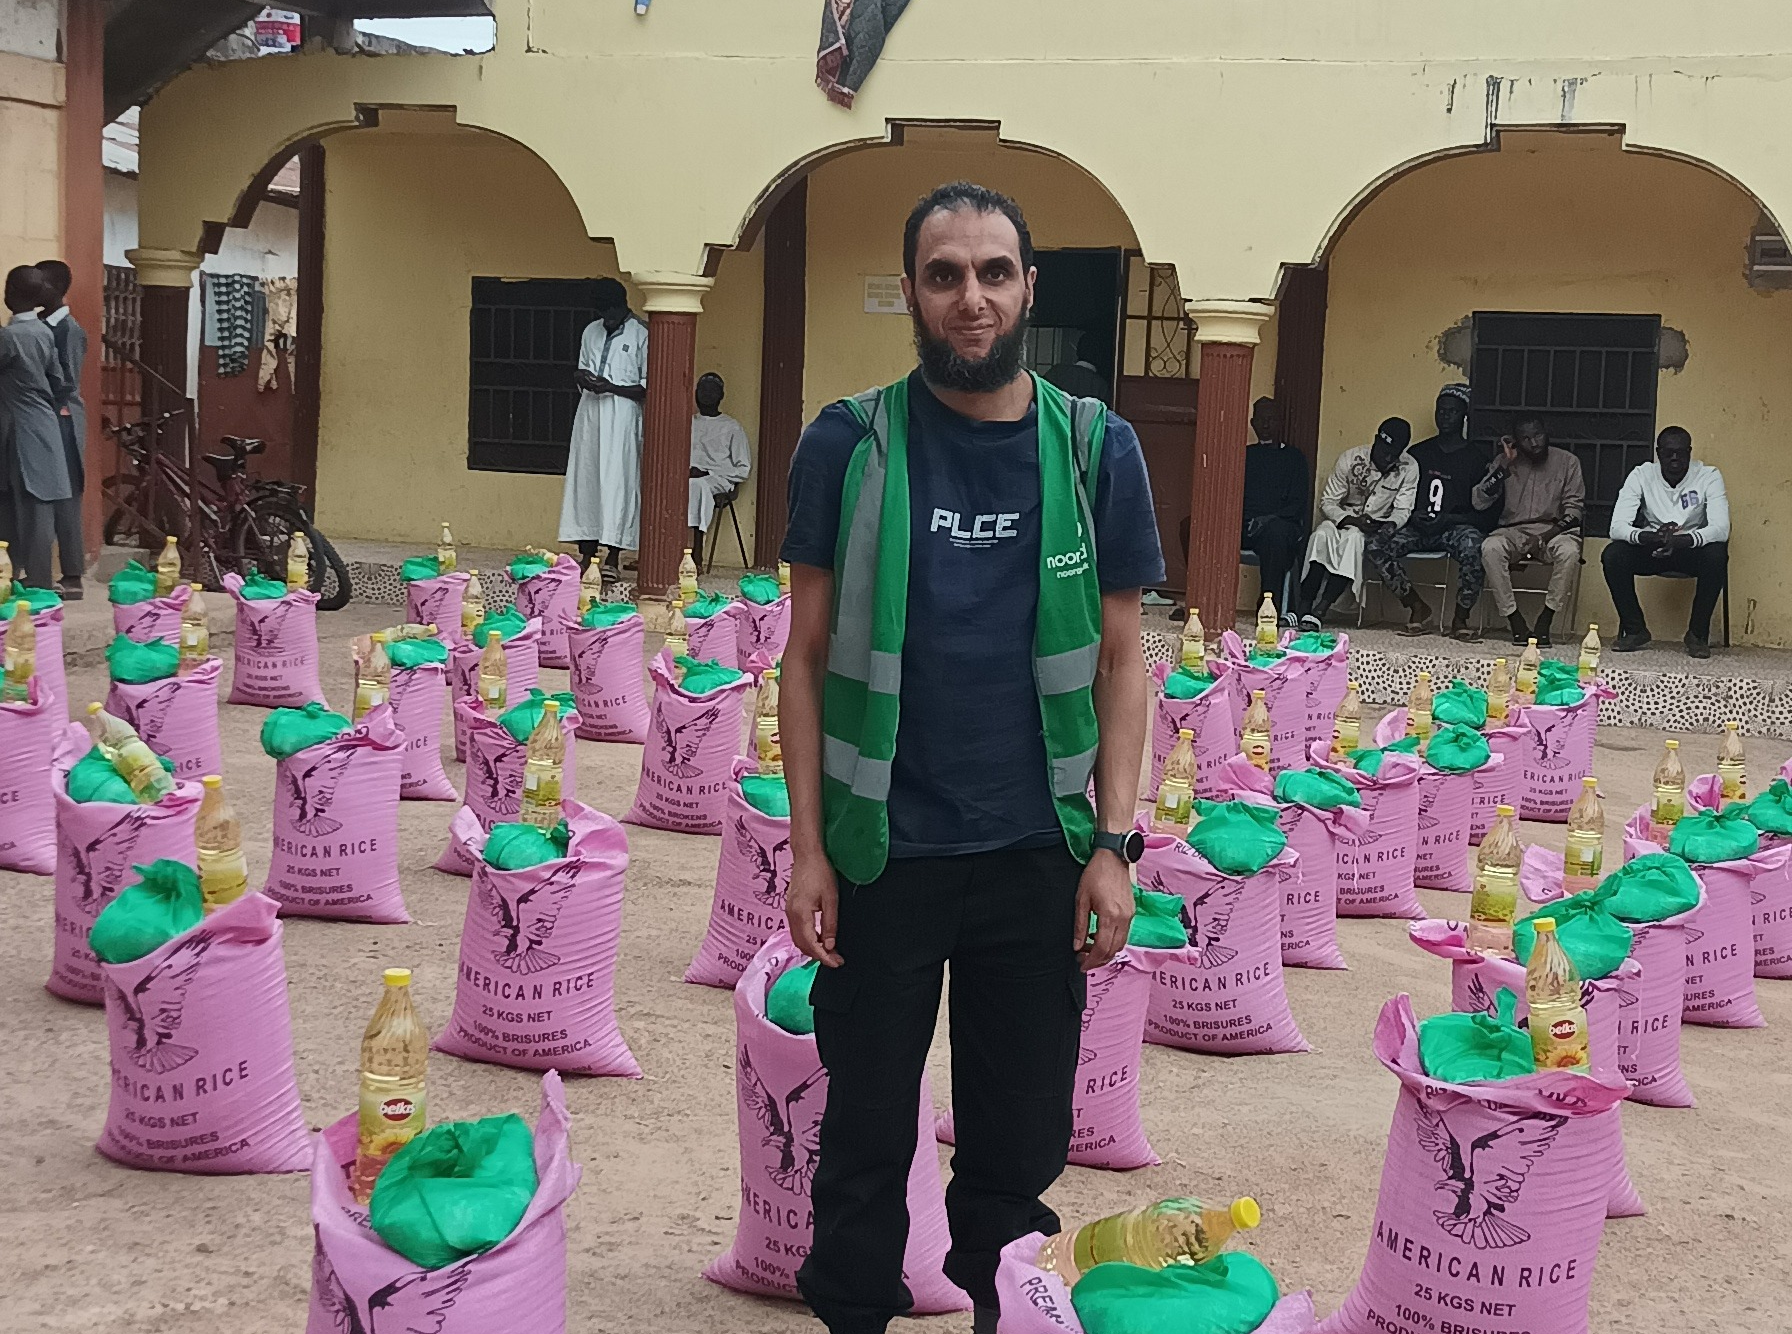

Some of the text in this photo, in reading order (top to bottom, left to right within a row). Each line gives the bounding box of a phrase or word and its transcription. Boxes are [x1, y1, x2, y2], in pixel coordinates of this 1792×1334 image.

[1428, 478, 1444, 512] 9
[603, 695, 627, 708] RICE
[1273, 730, 1295, 742] RICE
[1206, 753, 1228, 768] RICE
[1523, 769, 1564, 784] ERICAN
[0, 790, 20, 804] CE
[683, 801, 700, 809] NET
[1479, 794, 1506, 805] RICE
[668, 810, 707, 821] BROKENS
[1433, 830, 1461, 845] RICE
[339, 838, 378, 857] RICE
[1376, 846, 1406, 863] RICE
[297, 867, 318, 877] KGS
[319, 867, 341, 877] NET
[1358, 871, 1376, 880] NET
[300, 883, 354, 895] BRISURES
[307, 898, 321, 906] OF
[323, 893, 374, 906] AMERICA
[1286, 890, 1321, 906] RICE
[1358, 892, 1400, 905] AMERICA
[720, 898, 786, 931] AMERICA
[746, 934, 758, 946] 25
[1280, 939, 1311, 951] ERICA
[1752, 933, 1764, 943] ET
[718, 952, 748, 973] PROD
[735, 948, 755, 961] 100
[1702, 943, 1738, 965] RICE
[1754, 954, 1792, 968] MERICA
[1235, 961, 1271, 988] RICE
[552, 971, 595, 998] RICE
[1171, 998, 1238, 1012] 25 KGS NET
[482, 1004, 553, 1024] 25 KGS NET
[1163, 1013, 1253, 1030] 100% BRISURES
[472, 1019, 569, 1044] 100% BRISURES
[1148, 1018, 1273, 1042] PRODUCT OF AMERICA
[1631, 1014, 1669, 1035] RICE
[456, 1025, 593, 1058] PRODUCT OF AMERICA
[195, 1059, 249, 1098] RICE
[1085, 1065, 1128, 1095] RICE
[170, 1111, 199, 1127] NET
[181, 1138, 251, 1164] AMERICA
[1068, 1134, 1117, 1153] MERICA
[765, 1236, 781, 1254] 25
[1376, 1219, 1577, 1288] AMERICAN RICE
[754, 1255, 790, 1280] 100%
[1414, 1282, 1516, 1318] 25 KGS NET
[1394, 1304, 1435, 1332] 100%
